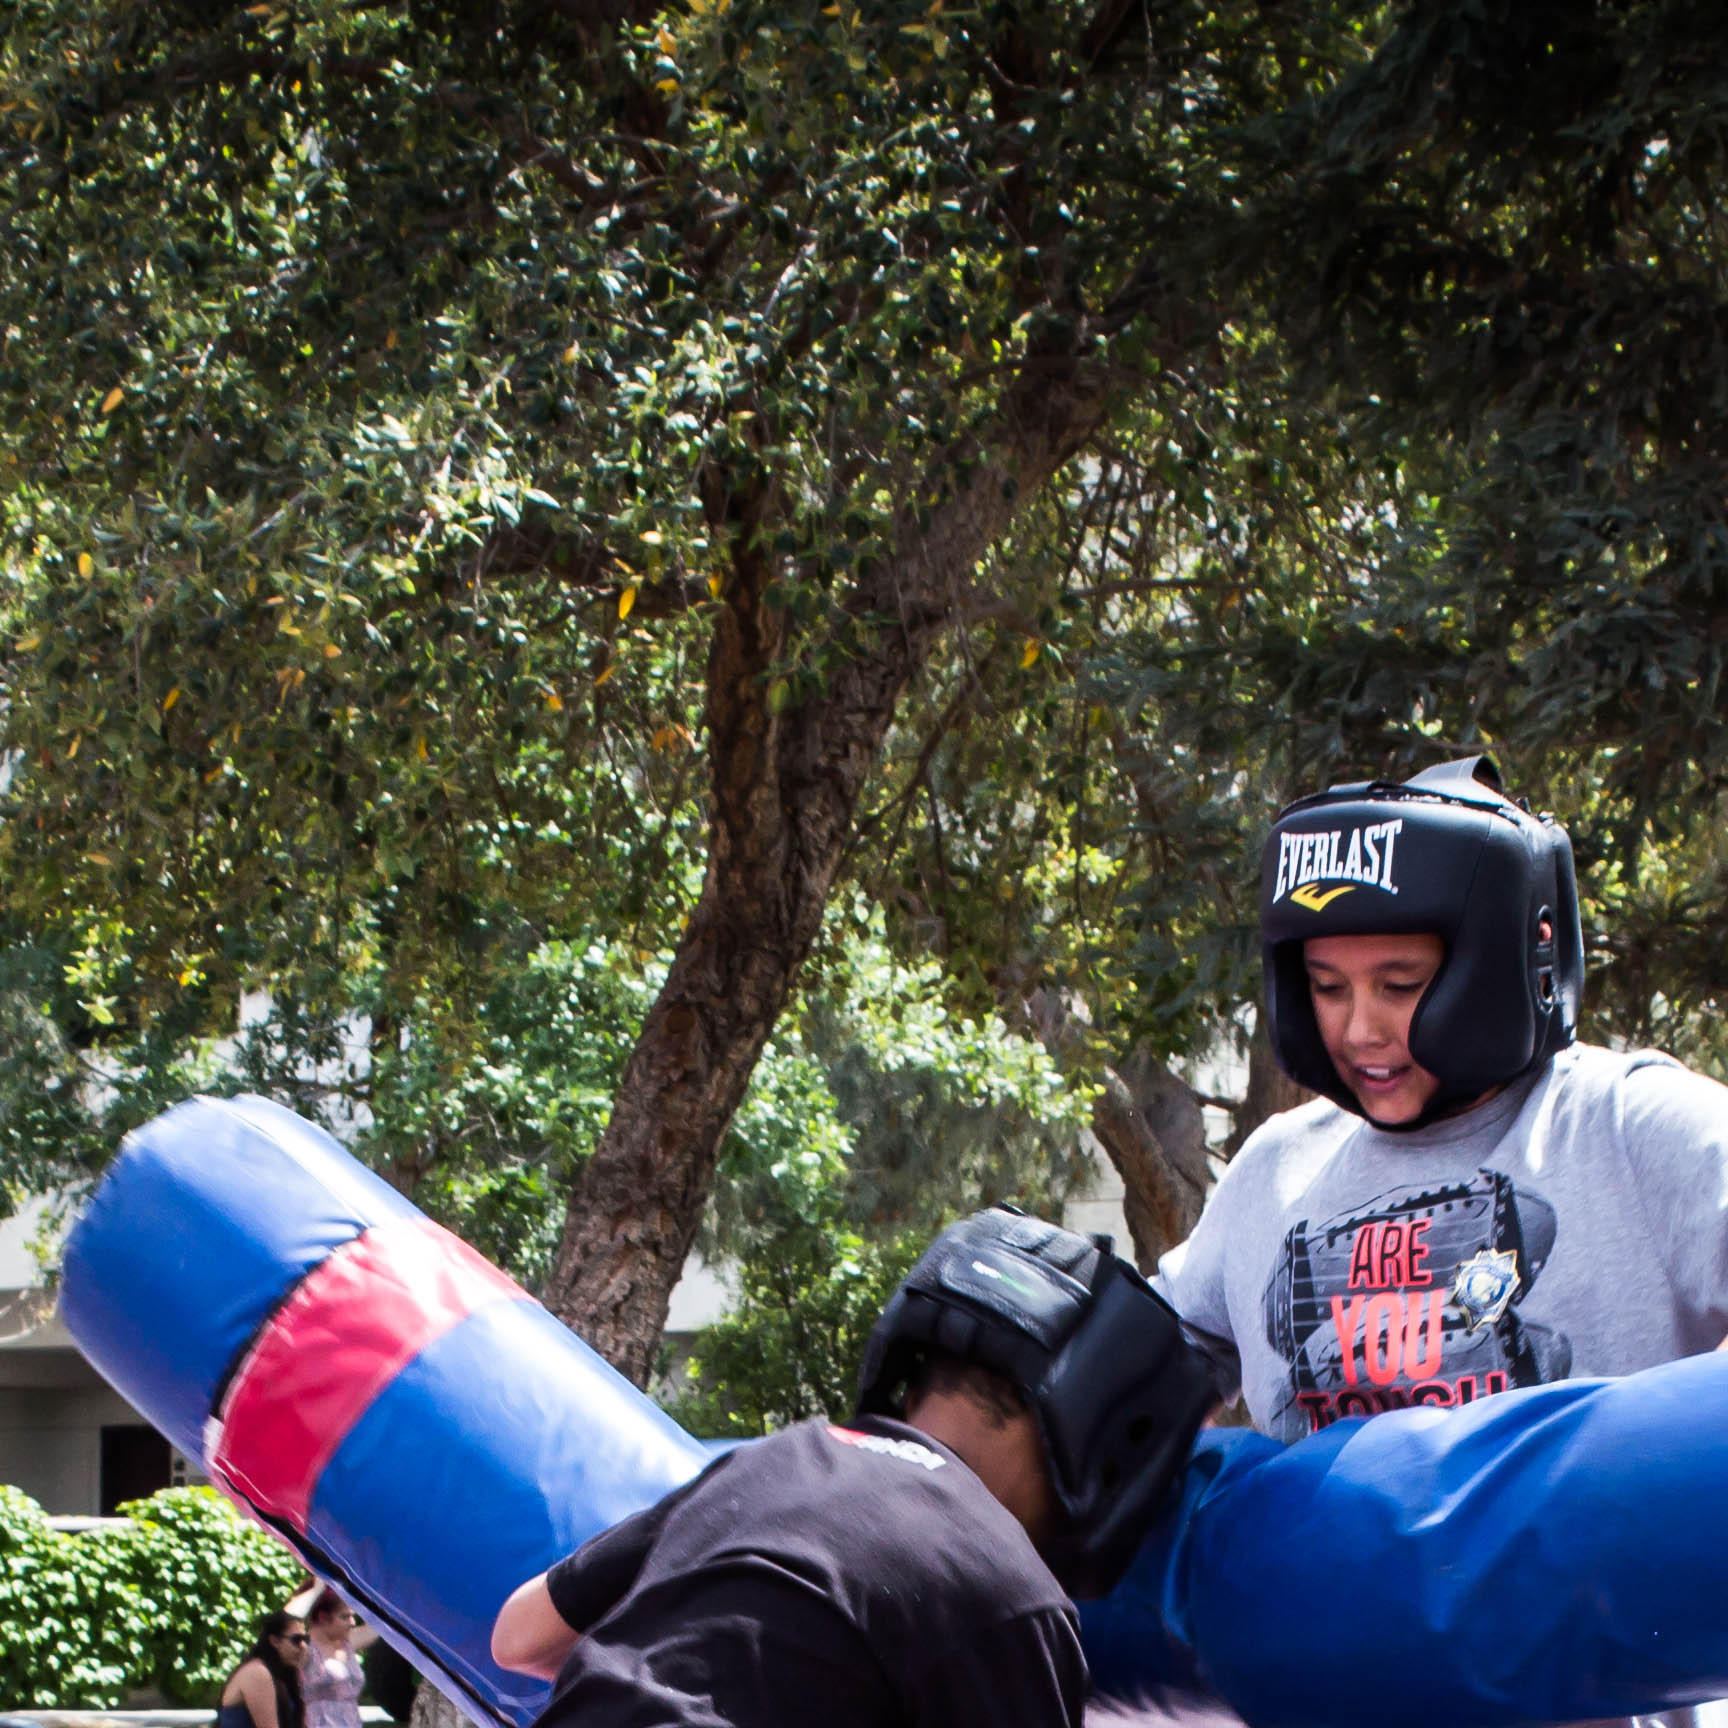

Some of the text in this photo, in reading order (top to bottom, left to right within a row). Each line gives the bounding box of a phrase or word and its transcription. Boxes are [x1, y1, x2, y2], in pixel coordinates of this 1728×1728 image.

[1272, 818, 1403, 904] EVERLAST
[1347, 1218, 1433, 1289] ARE
[1330, 1288, 1446, 1386] YOU
